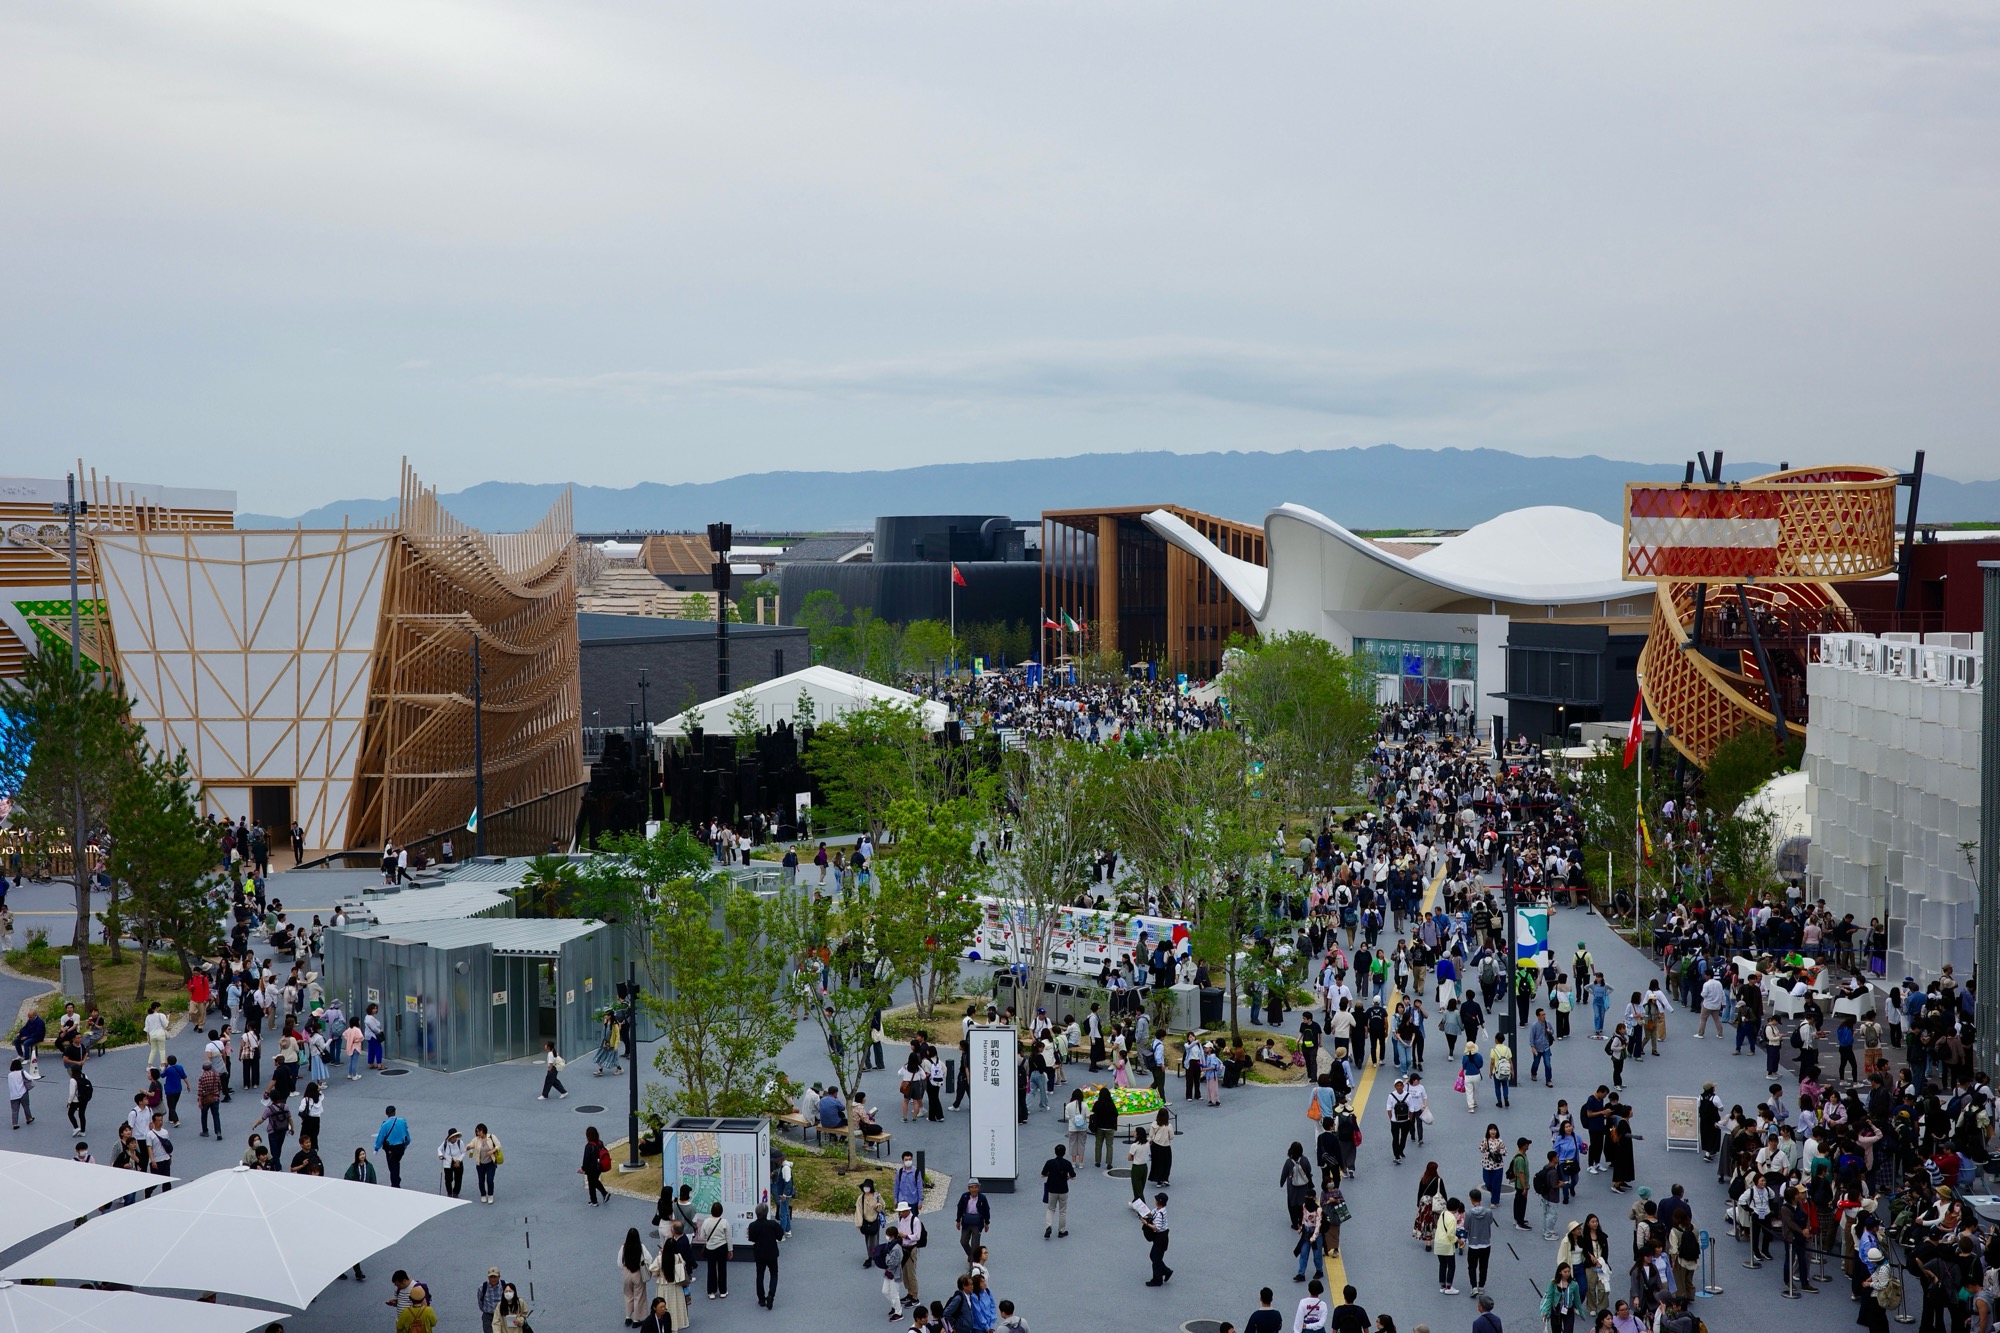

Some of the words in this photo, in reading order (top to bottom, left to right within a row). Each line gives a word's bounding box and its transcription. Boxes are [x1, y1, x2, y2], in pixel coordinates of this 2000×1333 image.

[990, 1039, 1000, 1087] 調和の広場
